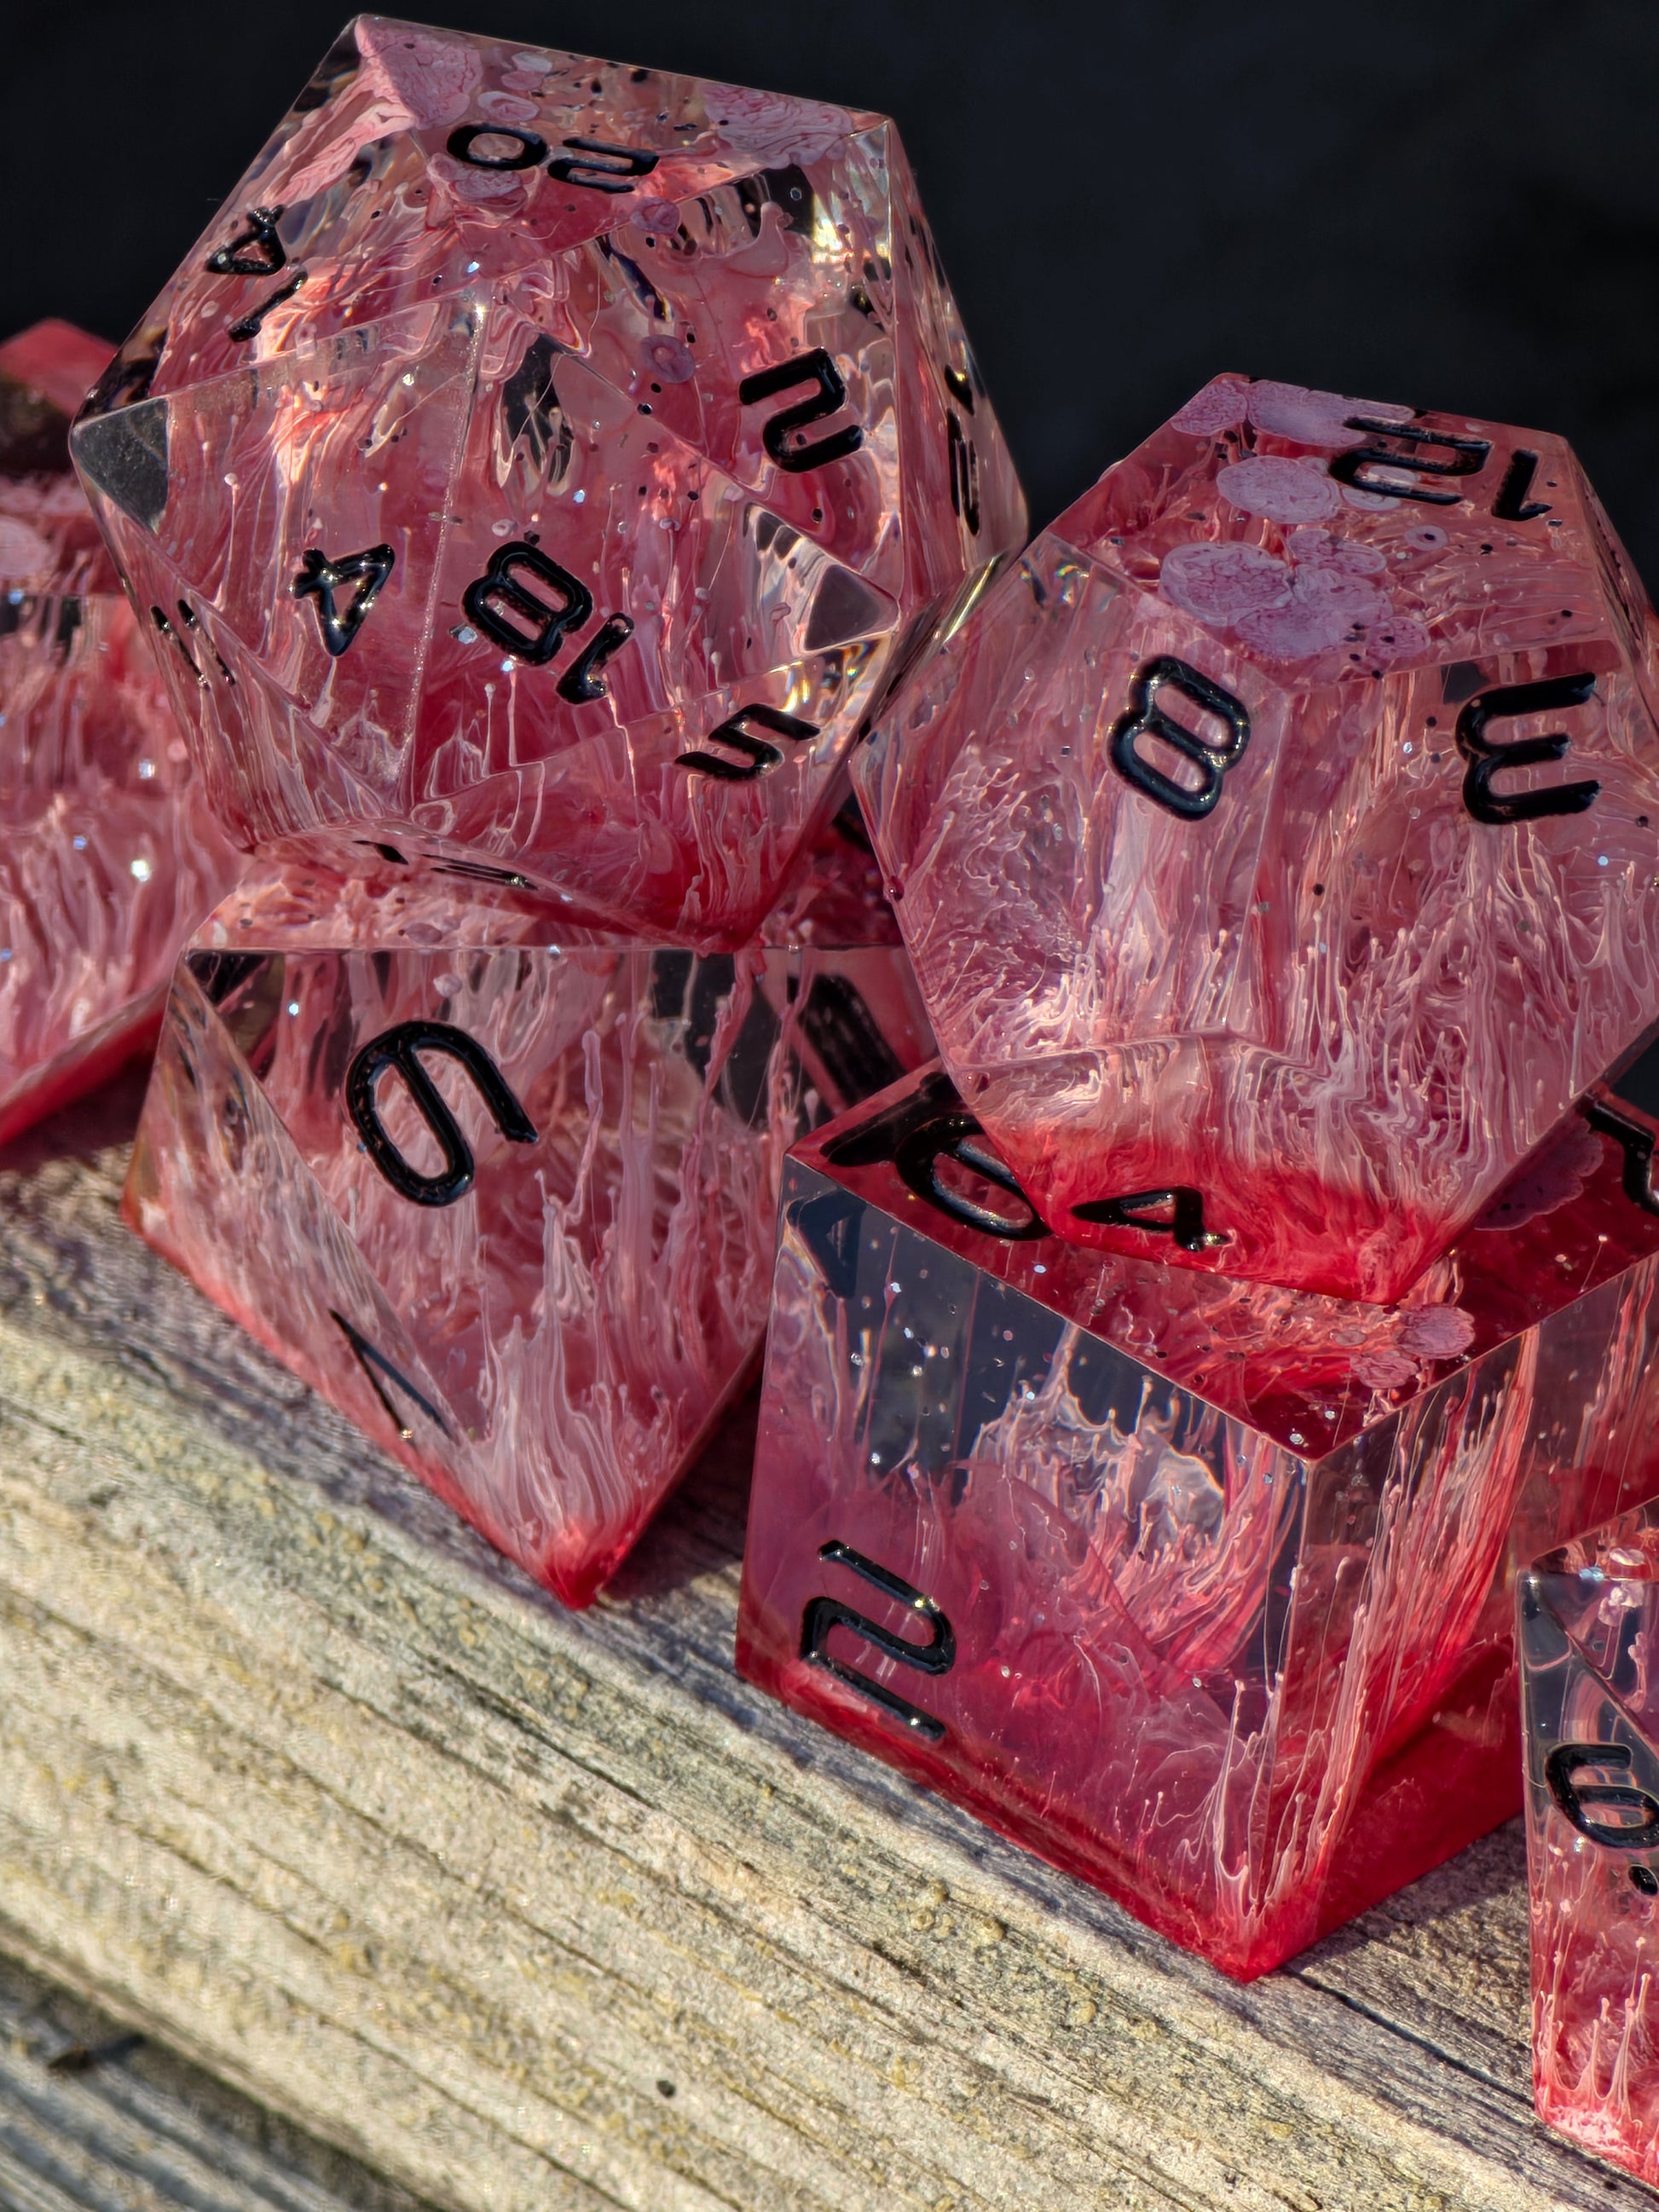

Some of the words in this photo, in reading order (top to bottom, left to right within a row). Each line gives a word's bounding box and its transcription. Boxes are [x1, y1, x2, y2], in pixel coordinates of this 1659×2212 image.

[446, 122, 661, 193] 20
[738, 347, 864, 472] 2
[1327, 416, 1554, 522] 12
[291, 543, 395, 656] 4
[462, 540, 635, 705] 18
[673, 702, 821, 782] 5
[1109, 654, 1251, 822] 8
[1071, 1186, 1231, 1252] 4
[799, 1539, 957, 1741] 2
